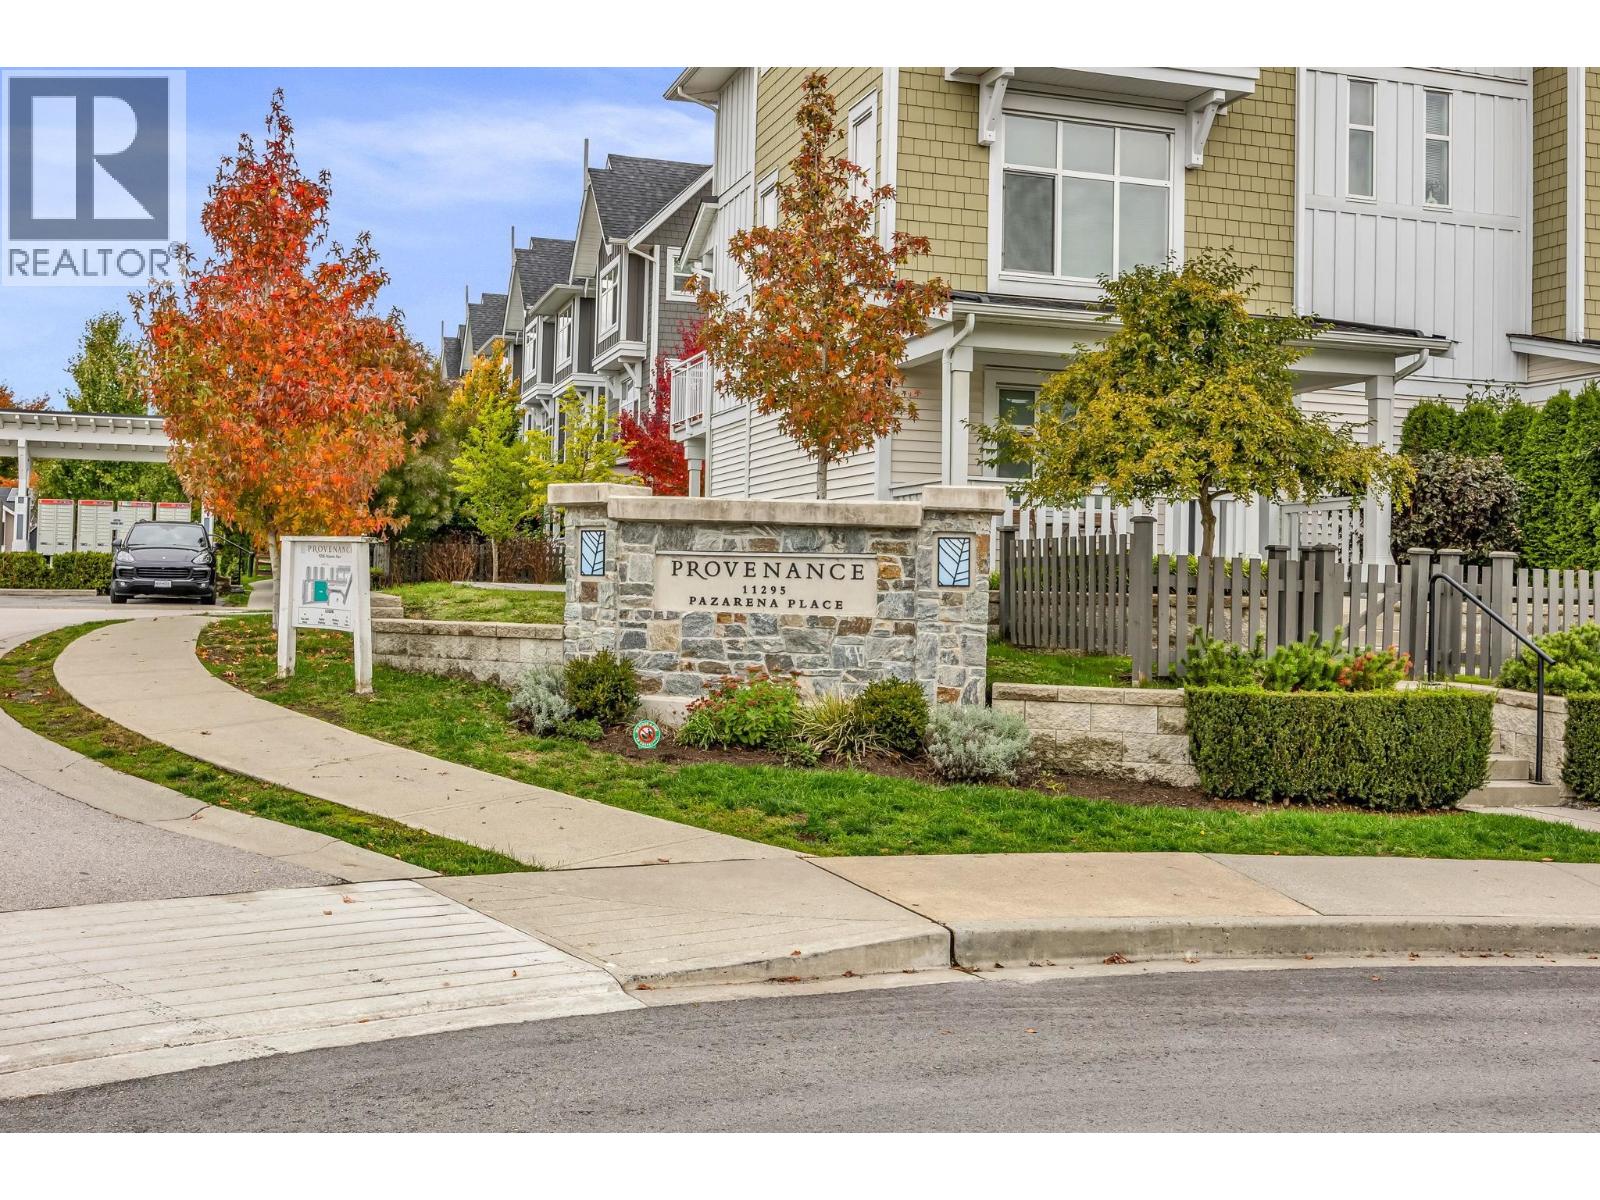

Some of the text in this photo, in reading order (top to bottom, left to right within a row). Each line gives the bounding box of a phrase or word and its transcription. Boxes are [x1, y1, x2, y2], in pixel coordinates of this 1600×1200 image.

[308, 544, 352, 554] PROVENANC
[671, 560, 865, 581] PROVENANCE
[742, 585, 786, 595] 11295
[689, 596, 844, 610] PAZARENA PLACE
